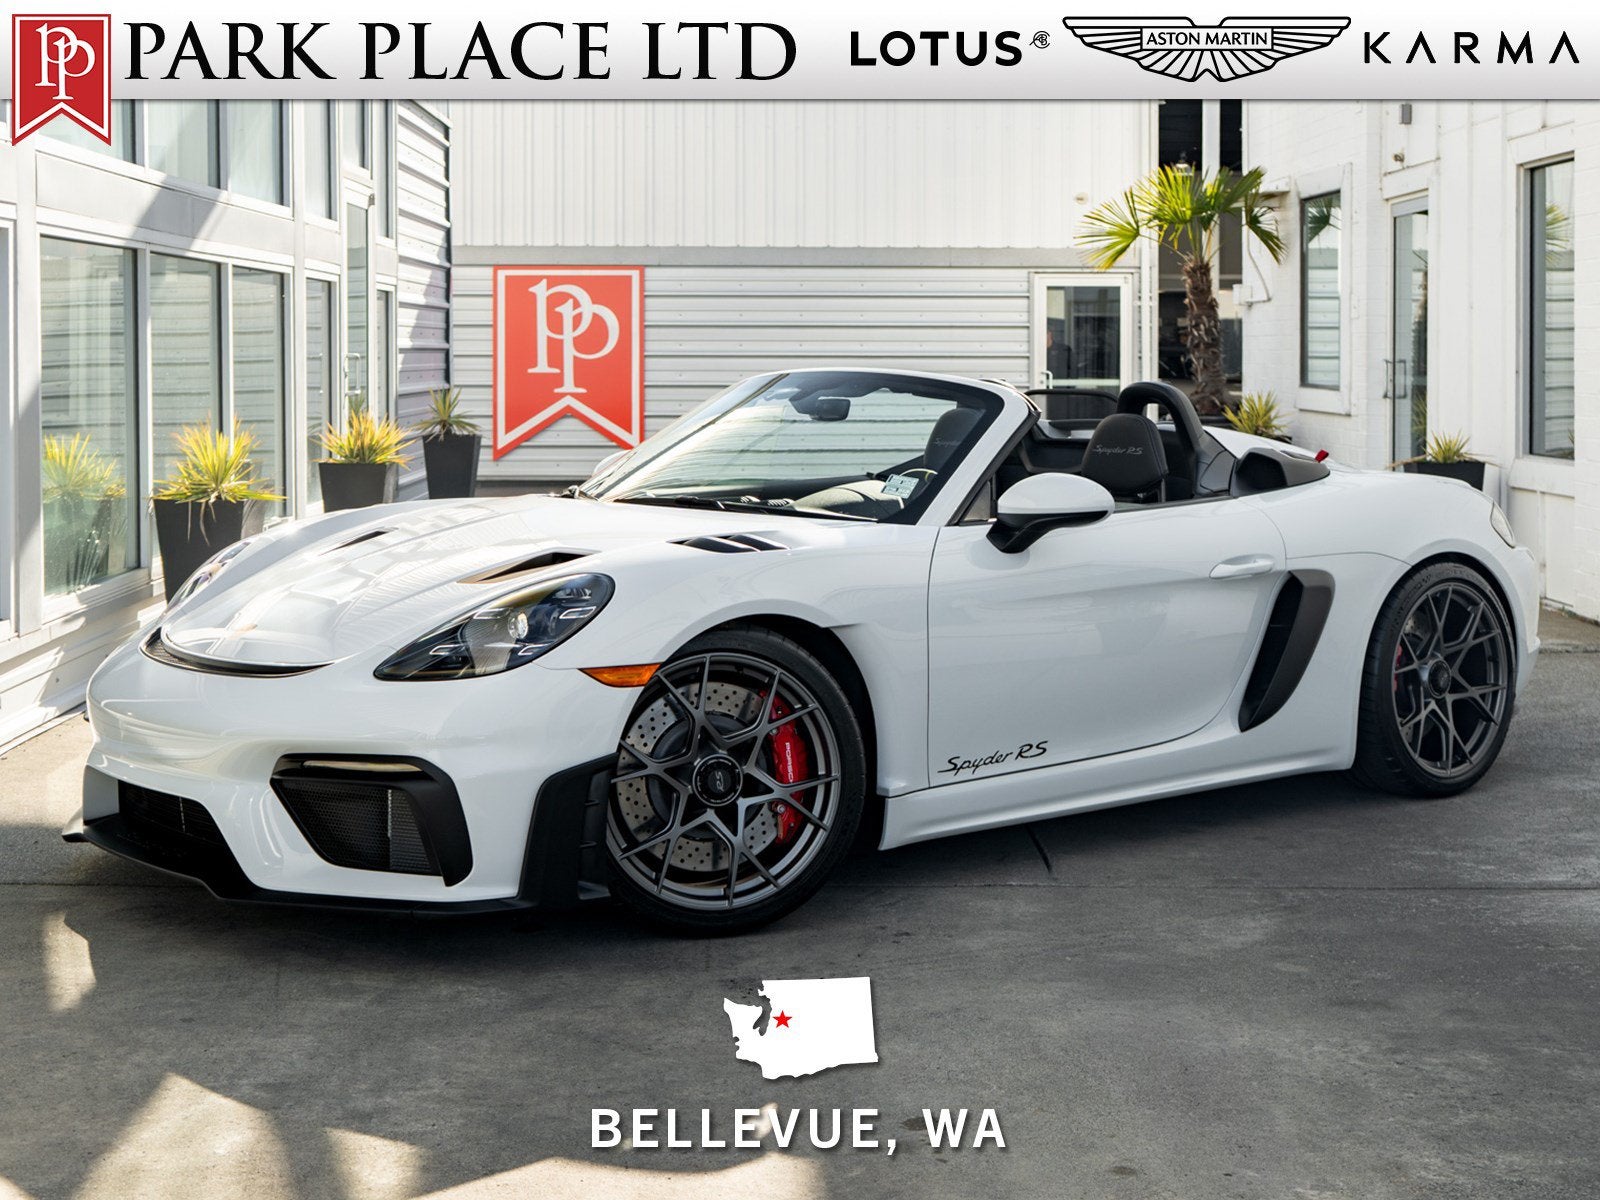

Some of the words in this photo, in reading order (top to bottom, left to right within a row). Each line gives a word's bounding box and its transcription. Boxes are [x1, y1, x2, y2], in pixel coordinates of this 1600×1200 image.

[1126, 446, 1143, 455] RS
[937, 750, 1013, 776] Spyder
[1014, 740, 1048, 760] RS
